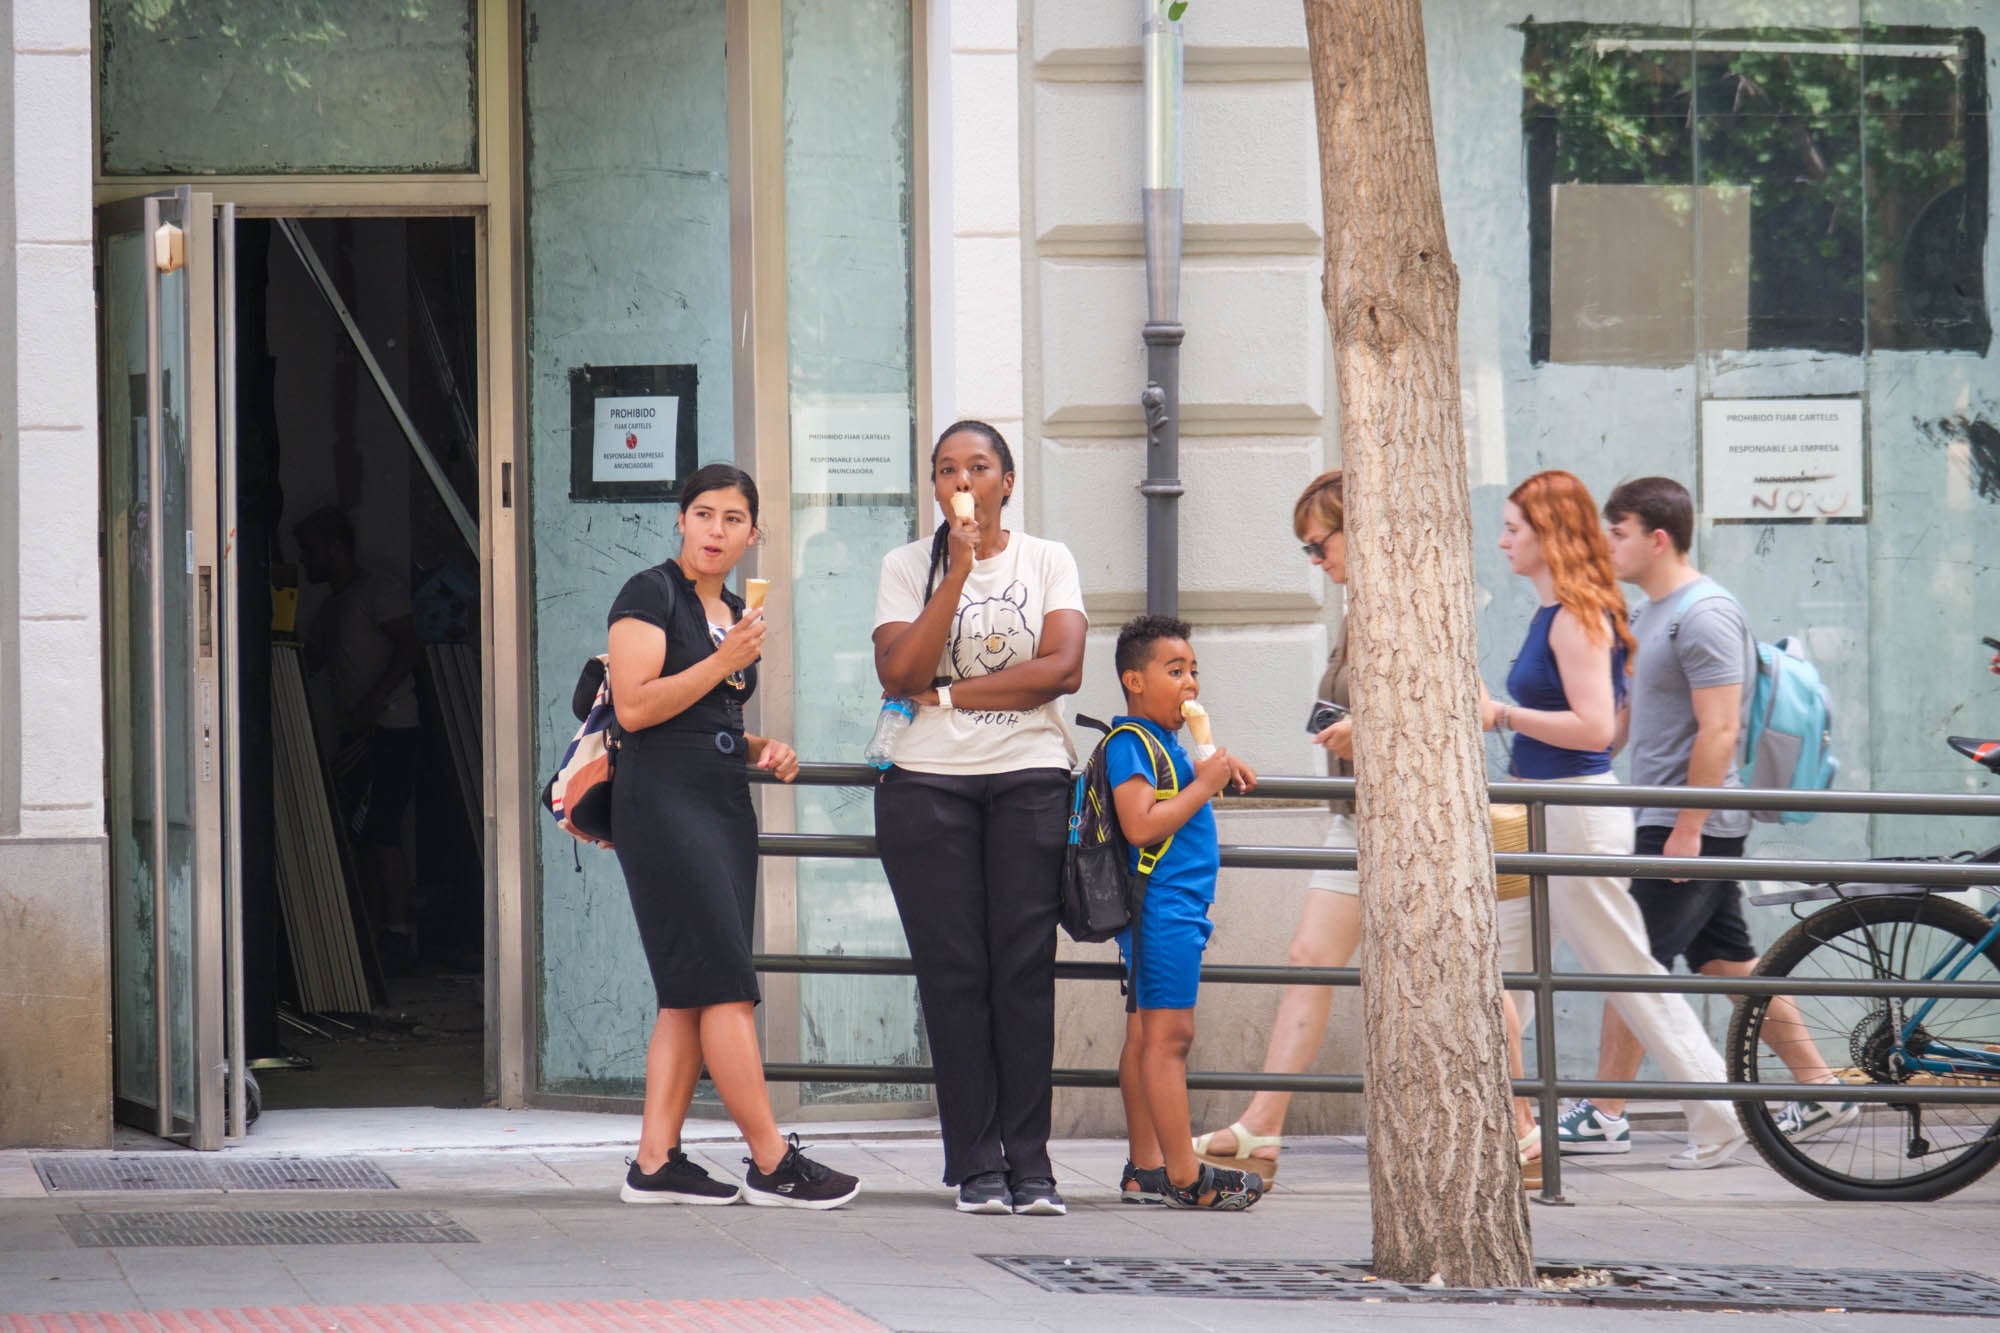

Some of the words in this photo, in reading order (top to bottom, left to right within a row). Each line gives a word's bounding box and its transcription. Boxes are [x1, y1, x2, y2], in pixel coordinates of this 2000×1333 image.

[610, 407, 656, 418] PROHIBIDO
[1726, 414, 1774, 423] PROHIBIDO
[1799, 413, 1839, 422] CARTELES
[628, 422, 652, 430] CARTELES
[1729, 444, 1787, 453] RESPONSABLE
[1788, 444, 1798, 452] LA
[1800, 443, 1840, 452] EMPRESA
[603, 452, 637, 460] RESPONSABLE
[1743, 1006, 1760, 1082] MAXXIS
